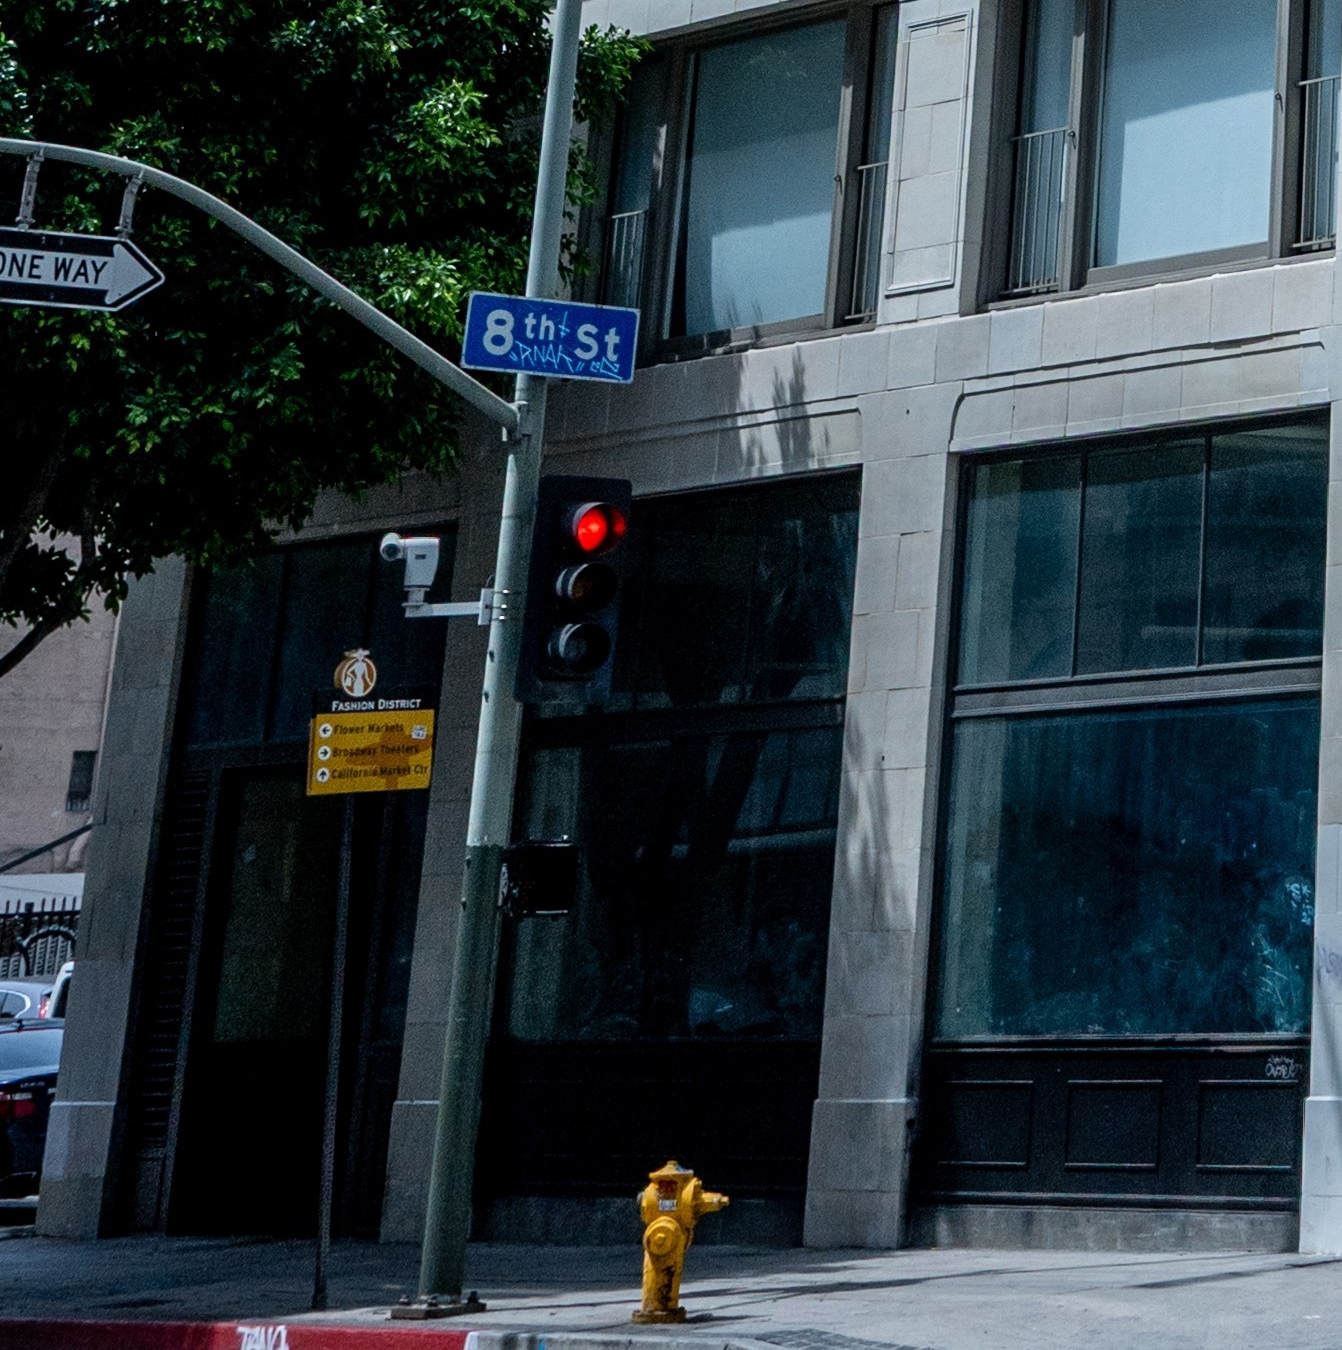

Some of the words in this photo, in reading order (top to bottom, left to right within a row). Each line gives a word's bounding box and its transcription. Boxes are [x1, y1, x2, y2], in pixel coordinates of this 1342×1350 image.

[54, 257, 108, 284] WAY
[482, 309, 555, 356] 8th
[574, 323, 620, 362] St
[331, 700, 375, 712] FASHION
[378, 698, 422, 710] DISTRICT
[333, 725, 365, 735] Flower
[368, 723, 404, 733] Markets
[332, 747, 377, 758] Broadway
[380, 765, 411, 777] Market
[414, 763, 429, 774] Ctr
